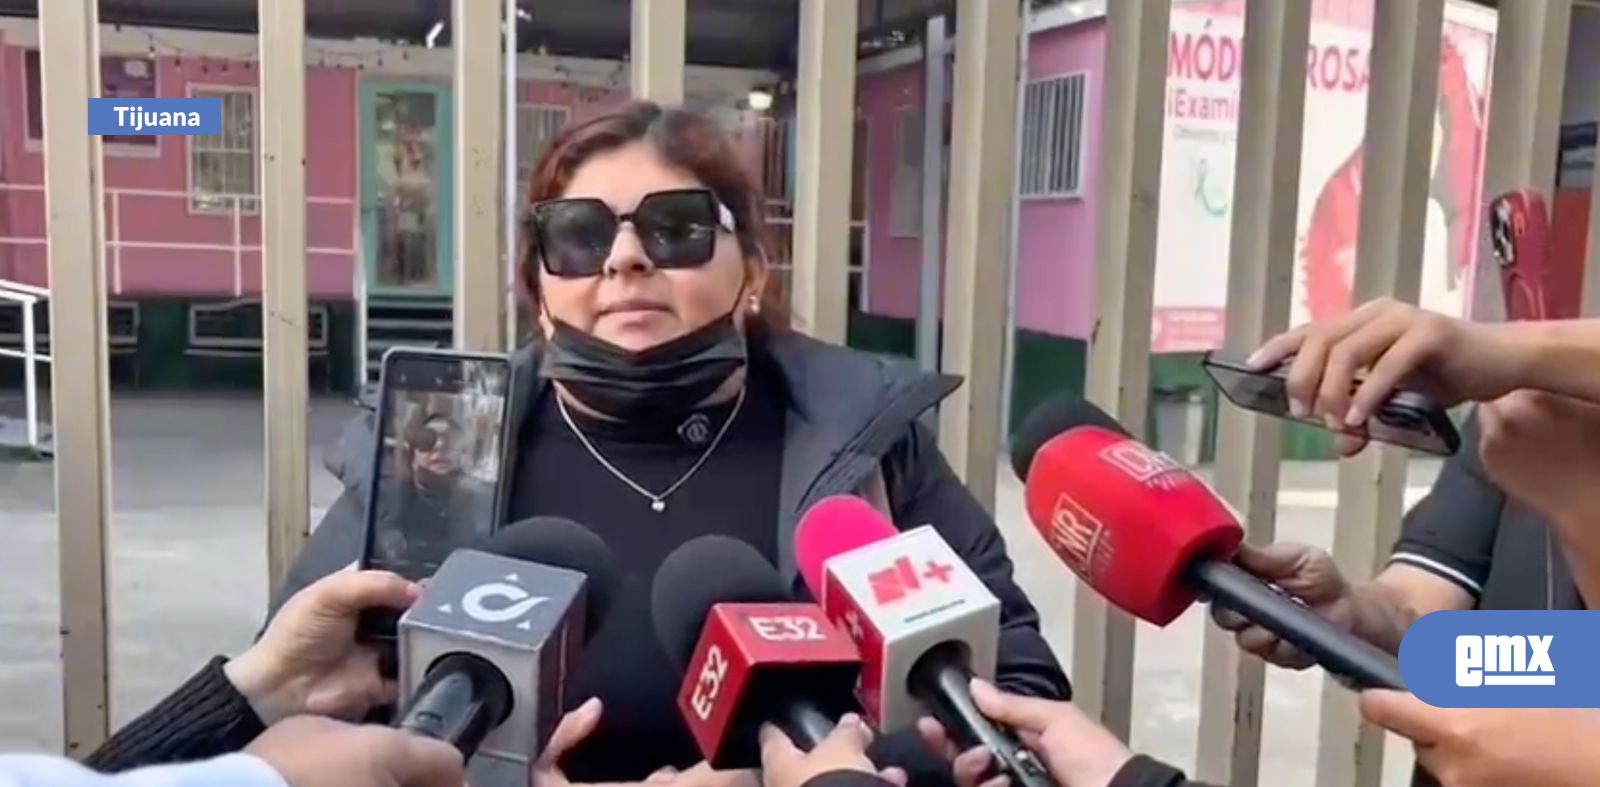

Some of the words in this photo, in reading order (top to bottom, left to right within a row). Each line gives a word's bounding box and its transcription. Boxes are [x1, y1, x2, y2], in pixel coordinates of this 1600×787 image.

[1167, 19, 1240, 81] MÓD
[749, 615, 826, 641] E32
[691, 644, 728, 720] E32
